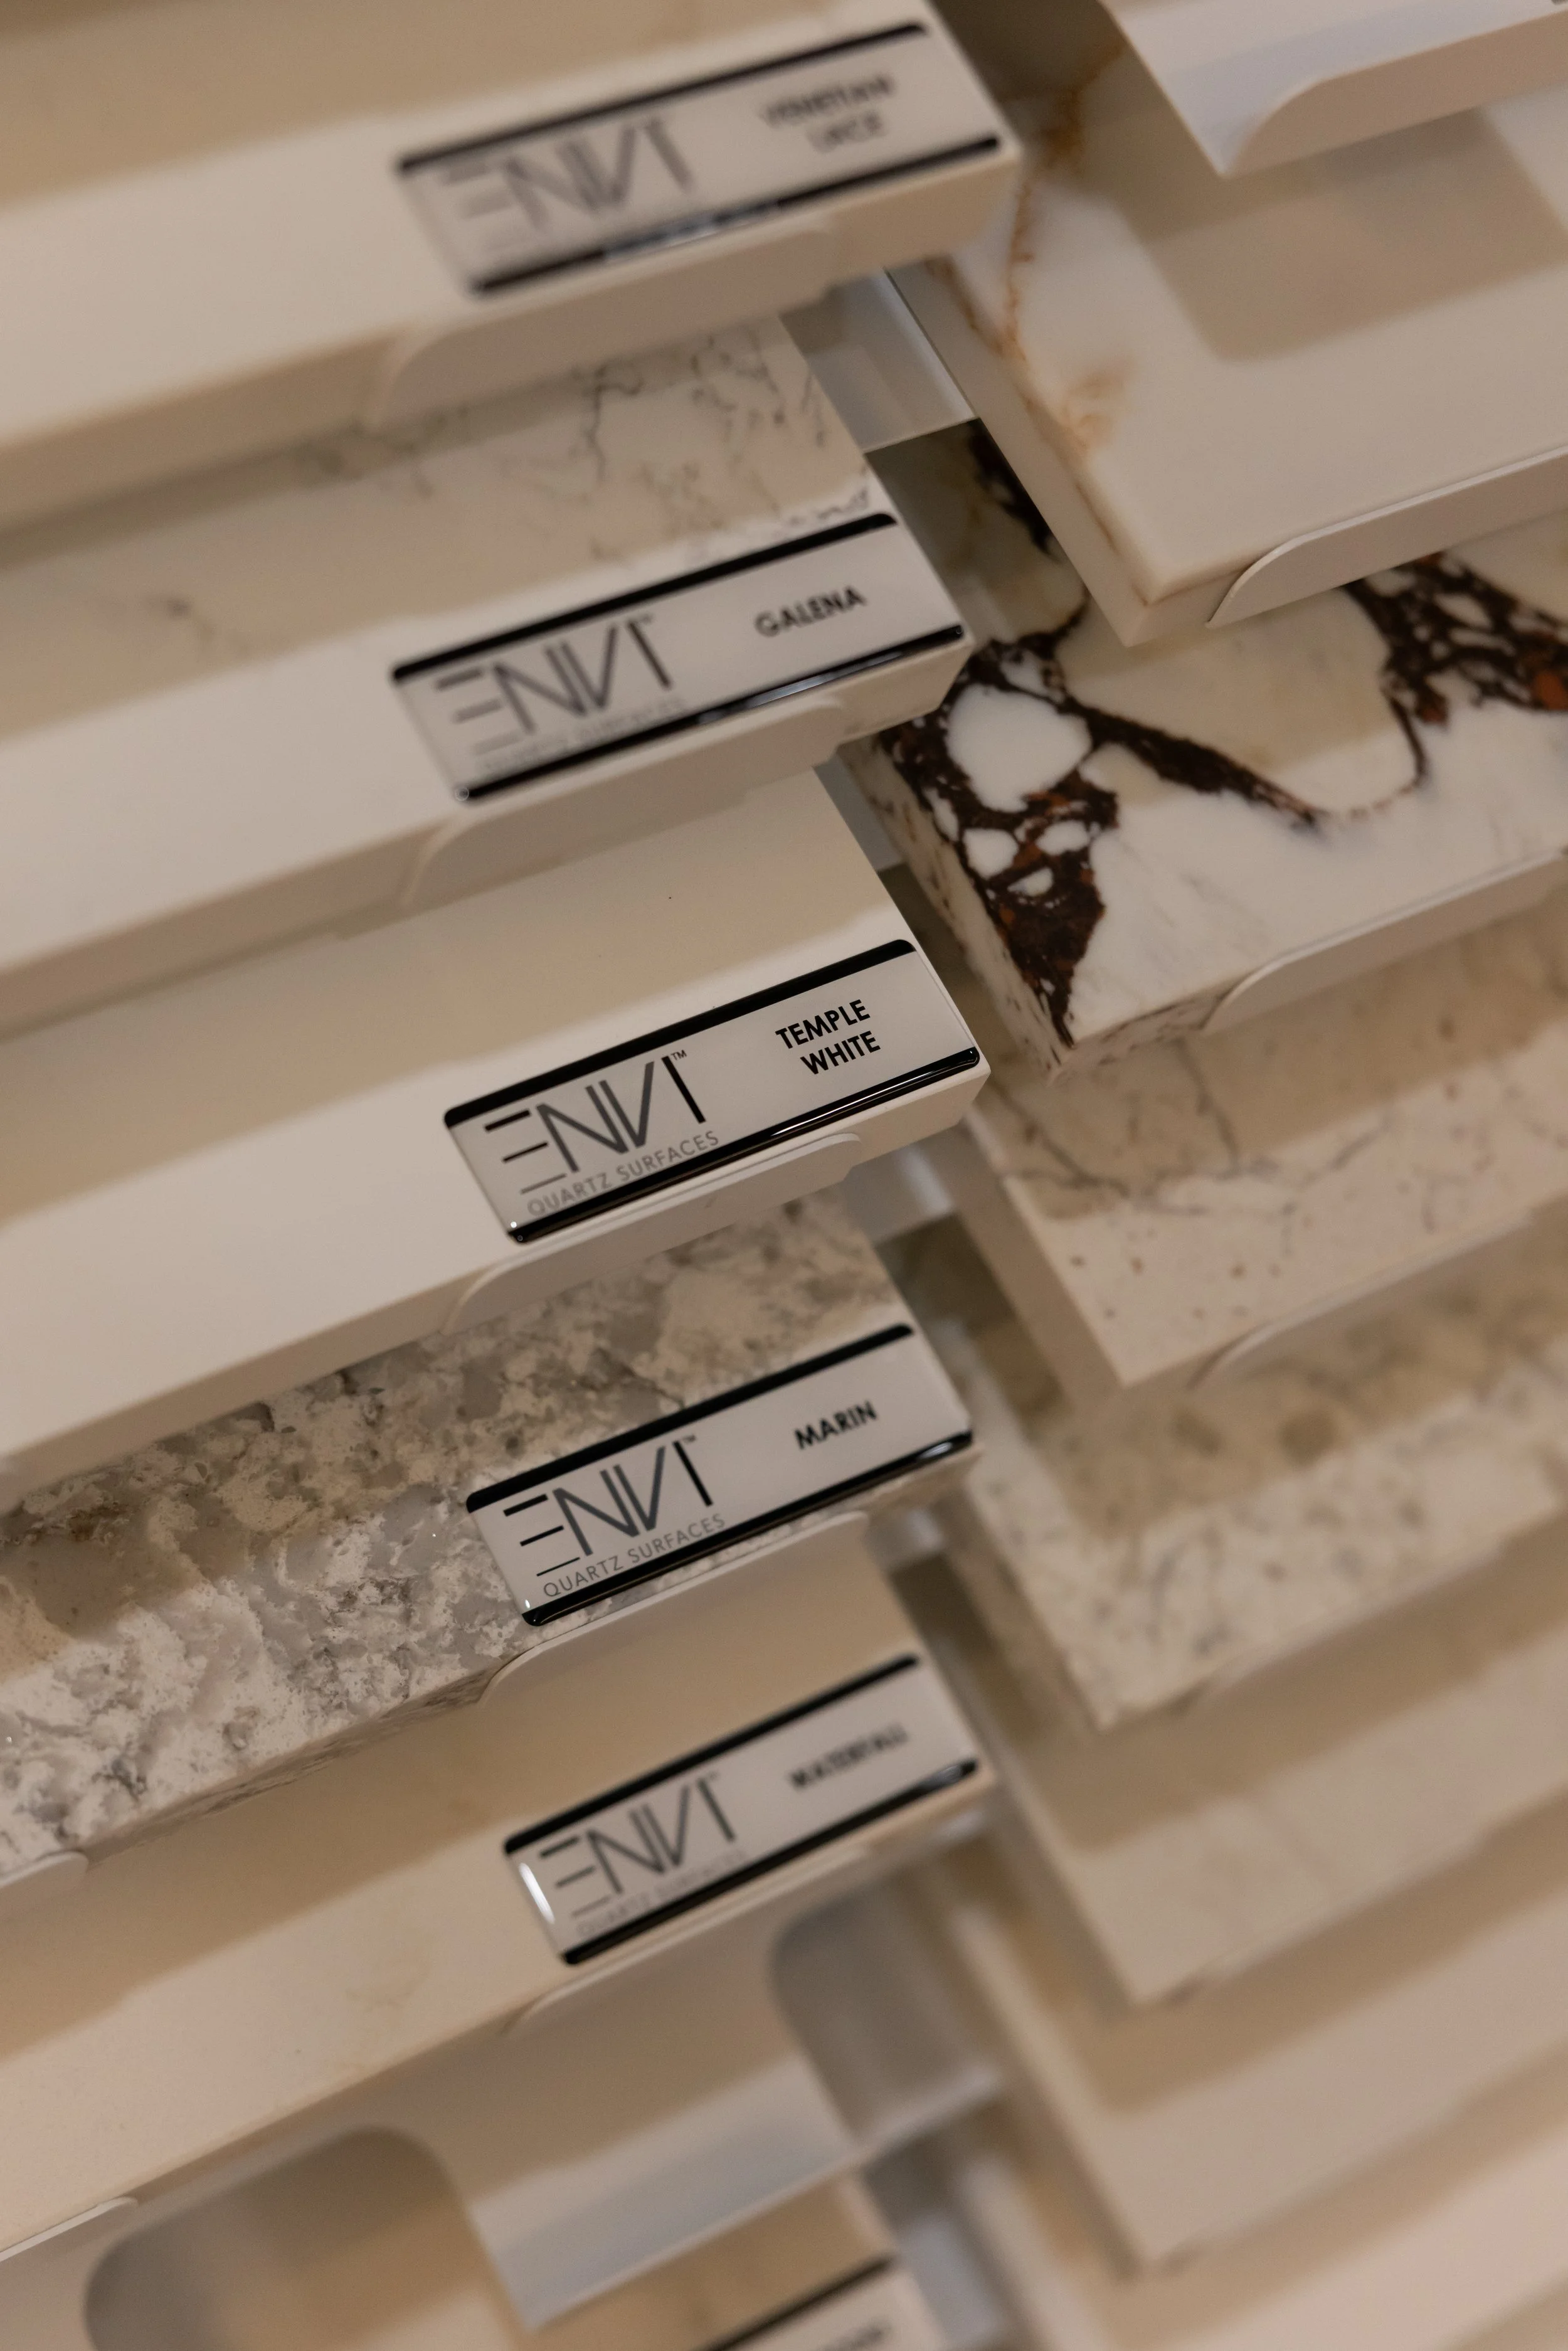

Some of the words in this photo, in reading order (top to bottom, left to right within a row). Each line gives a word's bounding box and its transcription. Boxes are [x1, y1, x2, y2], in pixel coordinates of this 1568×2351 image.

[756, 586, 867, 638] GALENA
[775, 999, 871, 1049] TEMPLE
[800, 1031, 881, 1075] WHITE
[527, 1172, 612, 1216] QUARTZ
[615, 1130, 719, 1182] SURFACES
[794, 1401, 878, 1450] MARIN
[543, 1556, 624, 1597] QUARTZ
[628, 1513, 726, 1563] SURFACES
